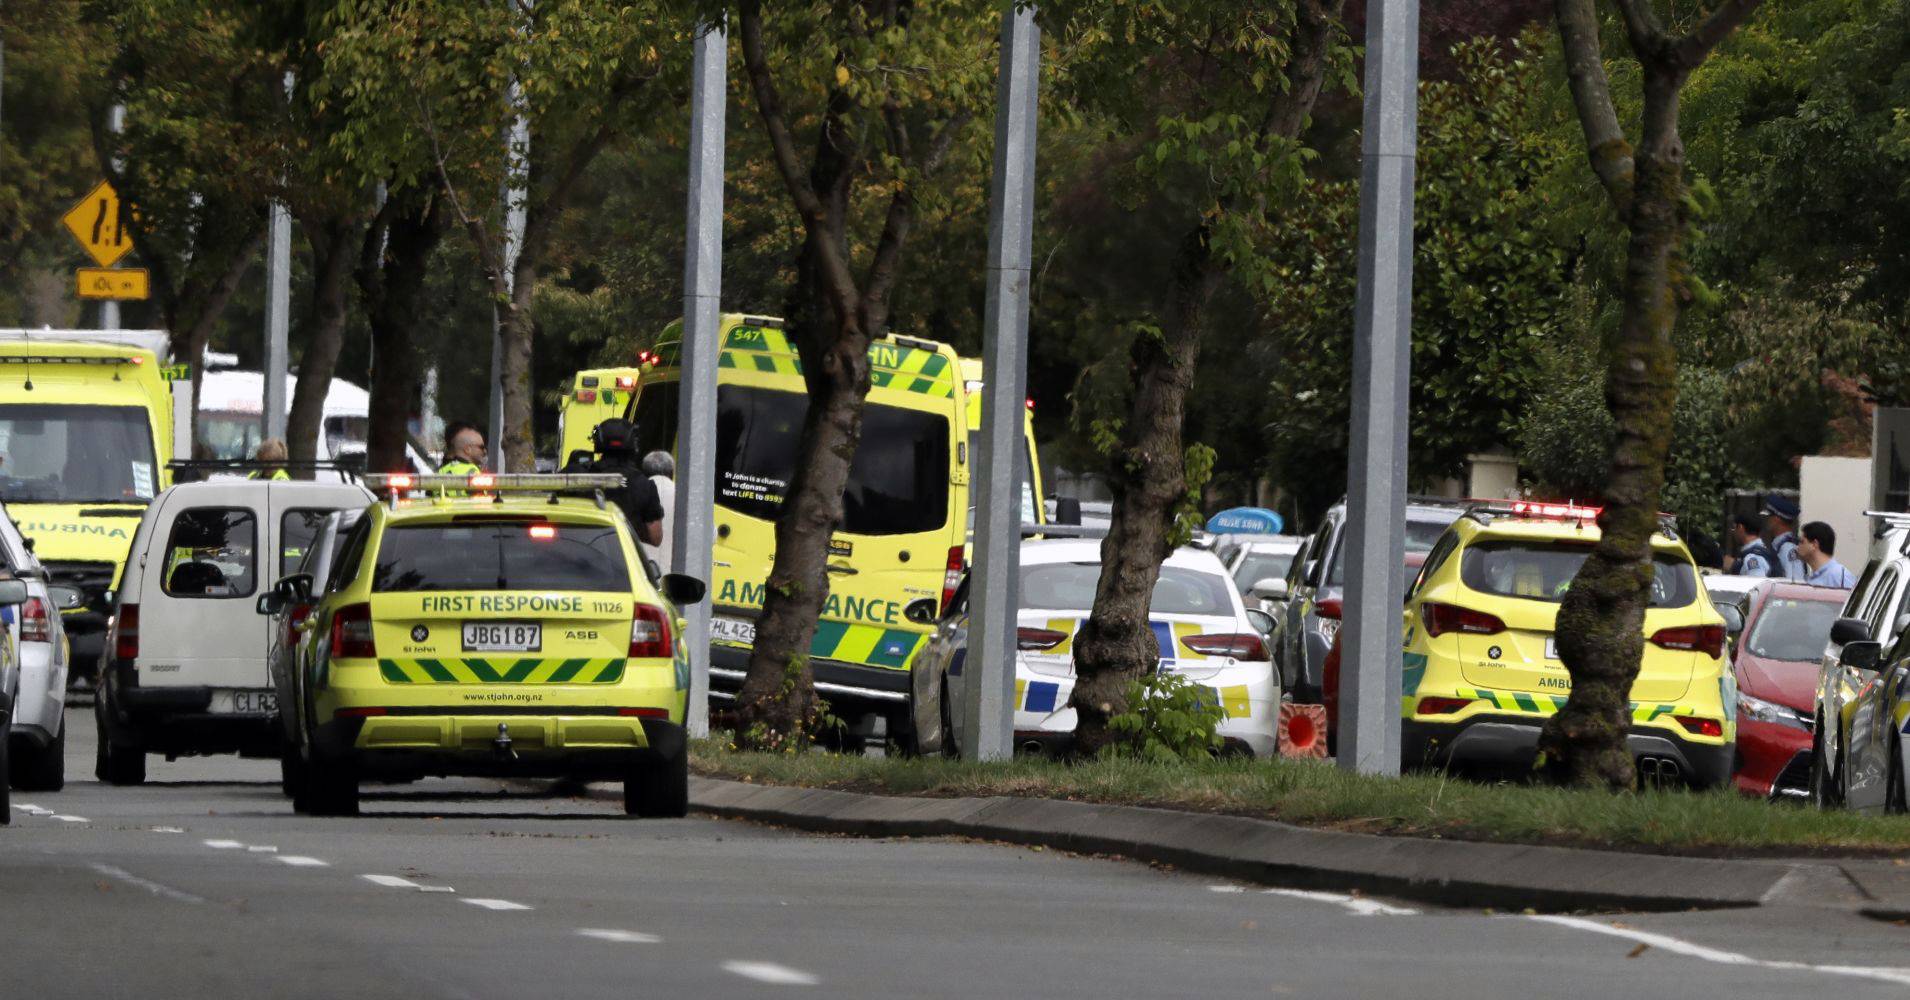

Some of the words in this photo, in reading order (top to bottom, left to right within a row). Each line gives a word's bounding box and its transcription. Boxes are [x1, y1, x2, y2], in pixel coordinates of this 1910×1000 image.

[734, 330, 760, 341] 547
[740, 483, 766, 491] donate
[723, 488, 738, 496] text
[739, 491, 753, 499] LIFE
[422, 596, 475, 612] FIRST
[480, 595, 583, 613] RESPONSE
[592, 601, 623, 613] 11126
[719, 578, 899, 625] AMANCE
[466, 626, 538, 645] JBG187
[712, 620, 756, 639] HL426
[463, 691, 543, 703] www.stjohn.org.nz
